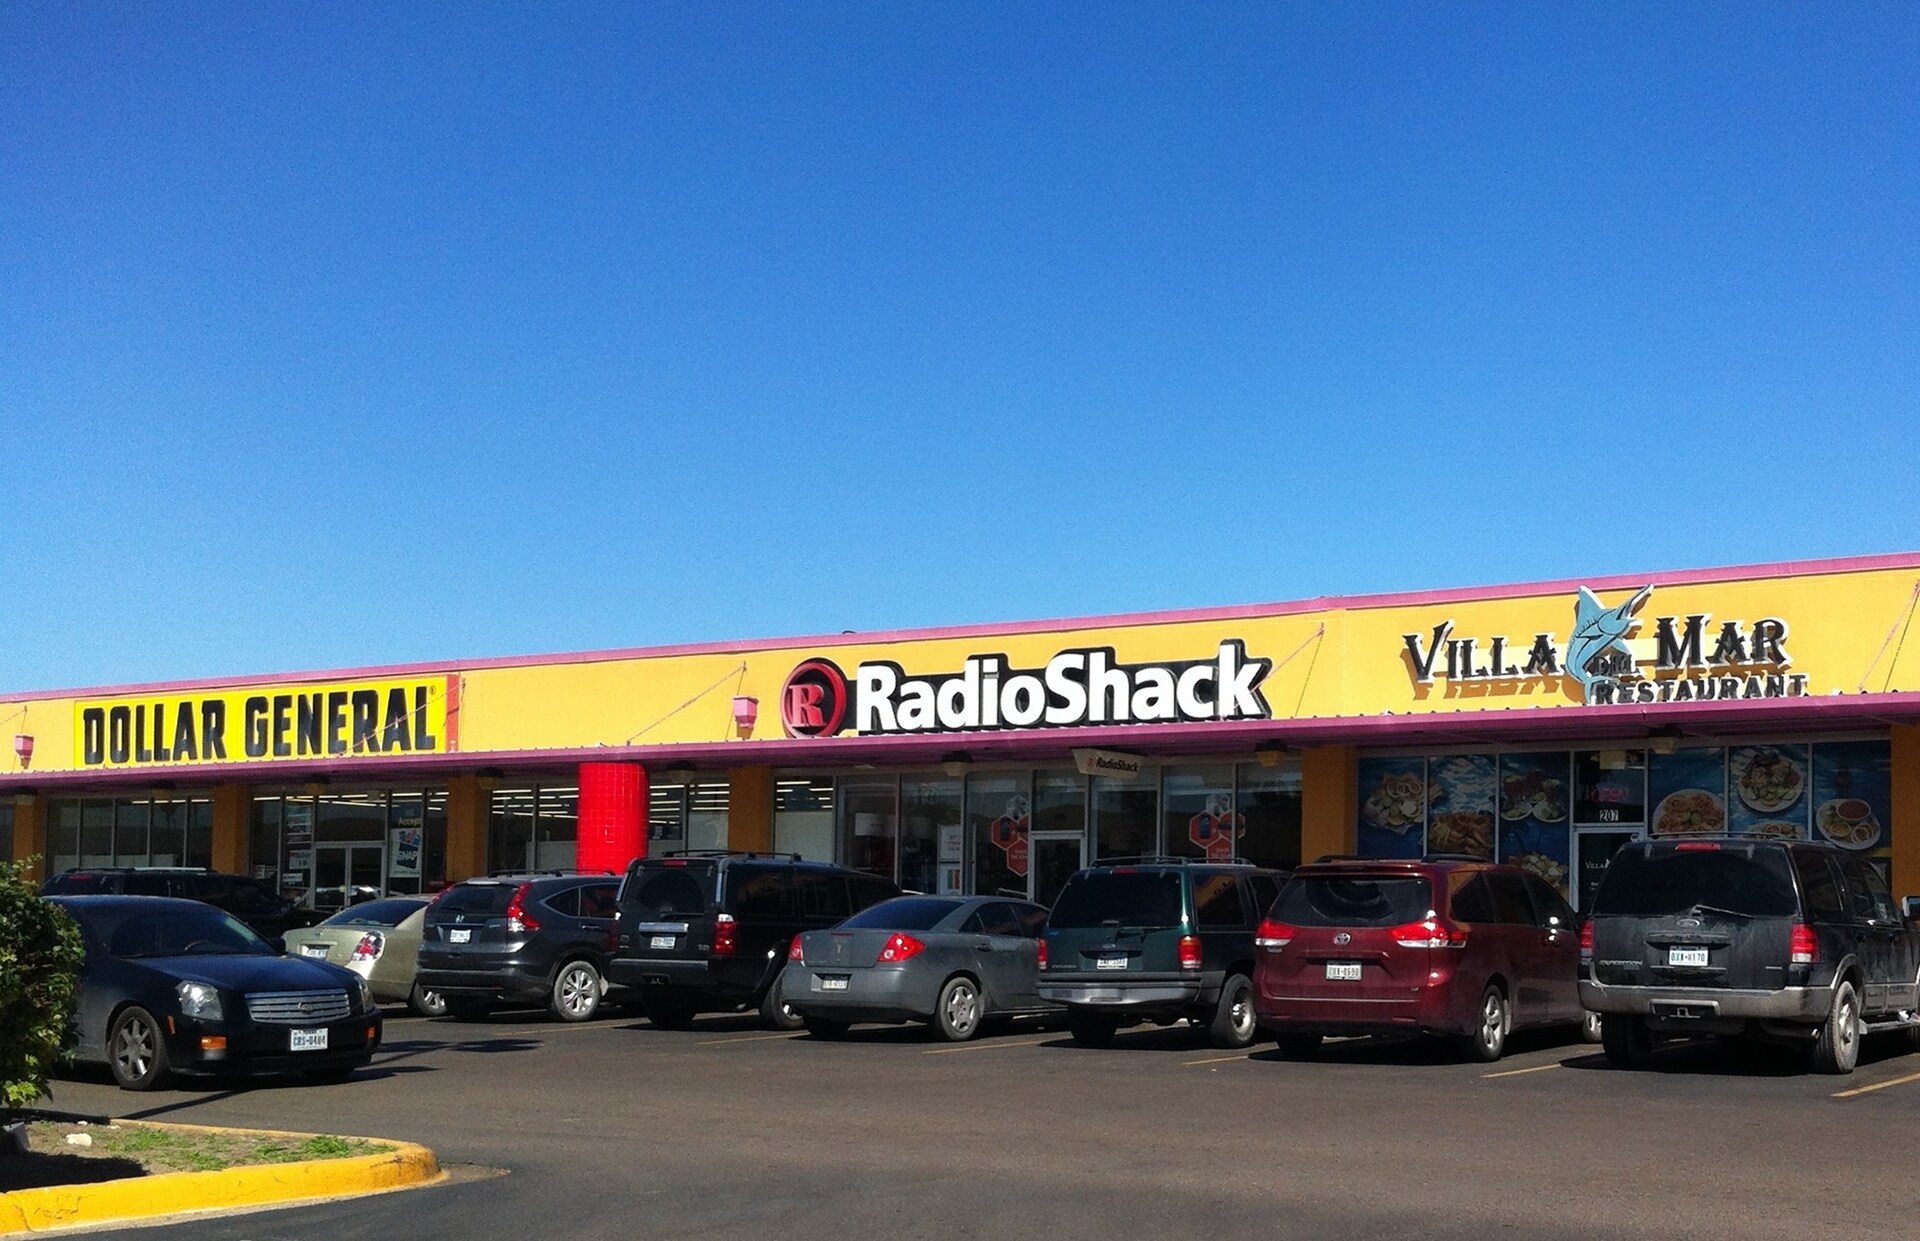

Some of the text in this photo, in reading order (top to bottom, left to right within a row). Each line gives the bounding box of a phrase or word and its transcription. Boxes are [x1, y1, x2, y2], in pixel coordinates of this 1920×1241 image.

[1403, 620, 1563, 681] VILLA
[1656, 614, 1792, 667] MAR
[856, 645, 1262, 731] RadioShack
[1594, 674, 1807, 704] RESTAURANT
[84, 685, 436, 765] DOLLAR GENERAL
[1096, 757, 1138, 772] RadioShack
[1600, 810, 1619, 821] 207
